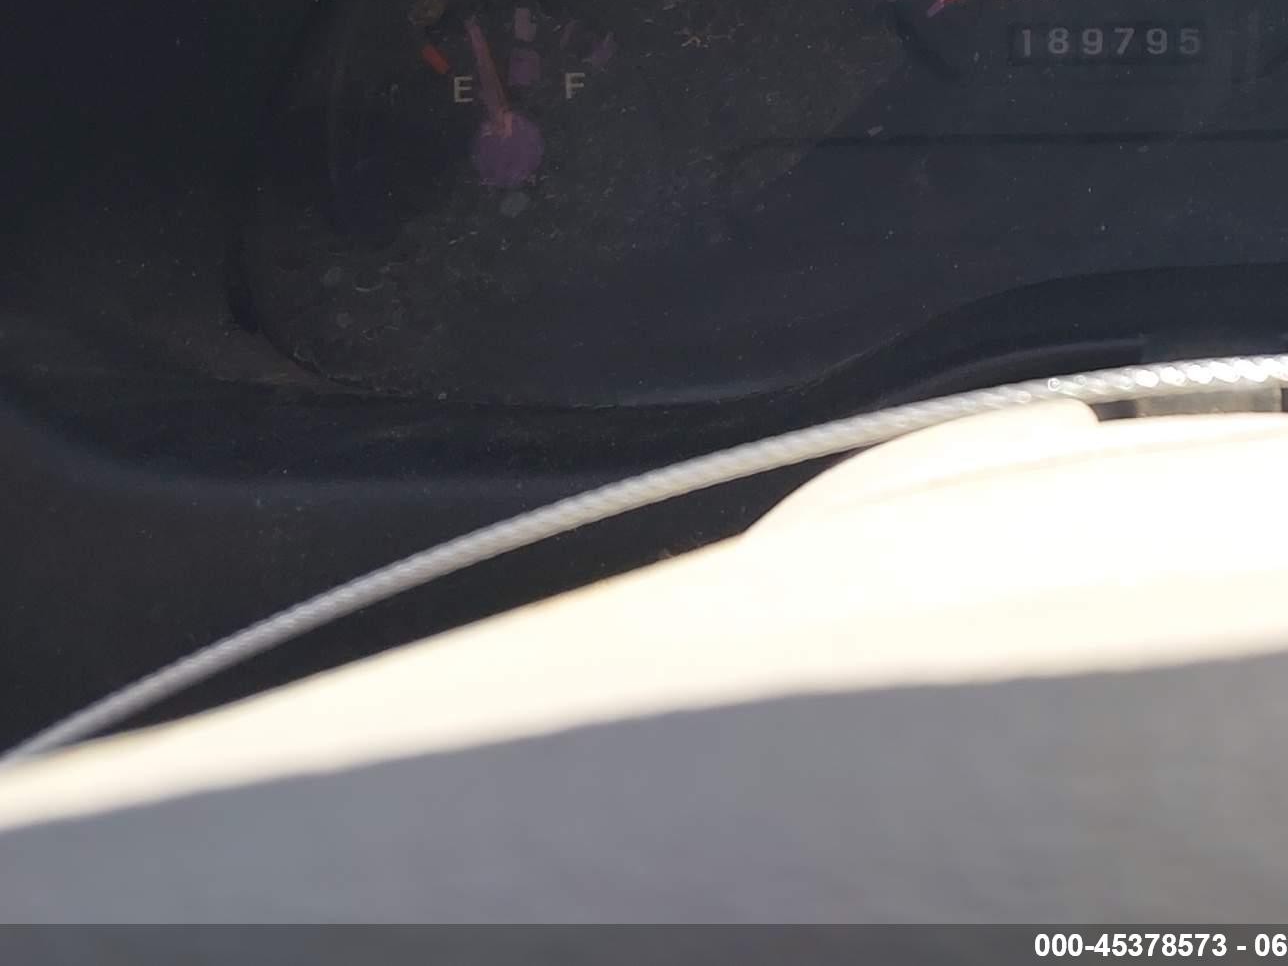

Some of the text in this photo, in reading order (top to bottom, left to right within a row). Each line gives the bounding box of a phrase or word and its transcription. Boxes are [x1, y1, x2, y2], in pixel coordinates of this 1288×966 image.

[1022, 27, 1200, 57] 189795
[453, 75, 474, 103] E
[564, 71, 585, 99] F
